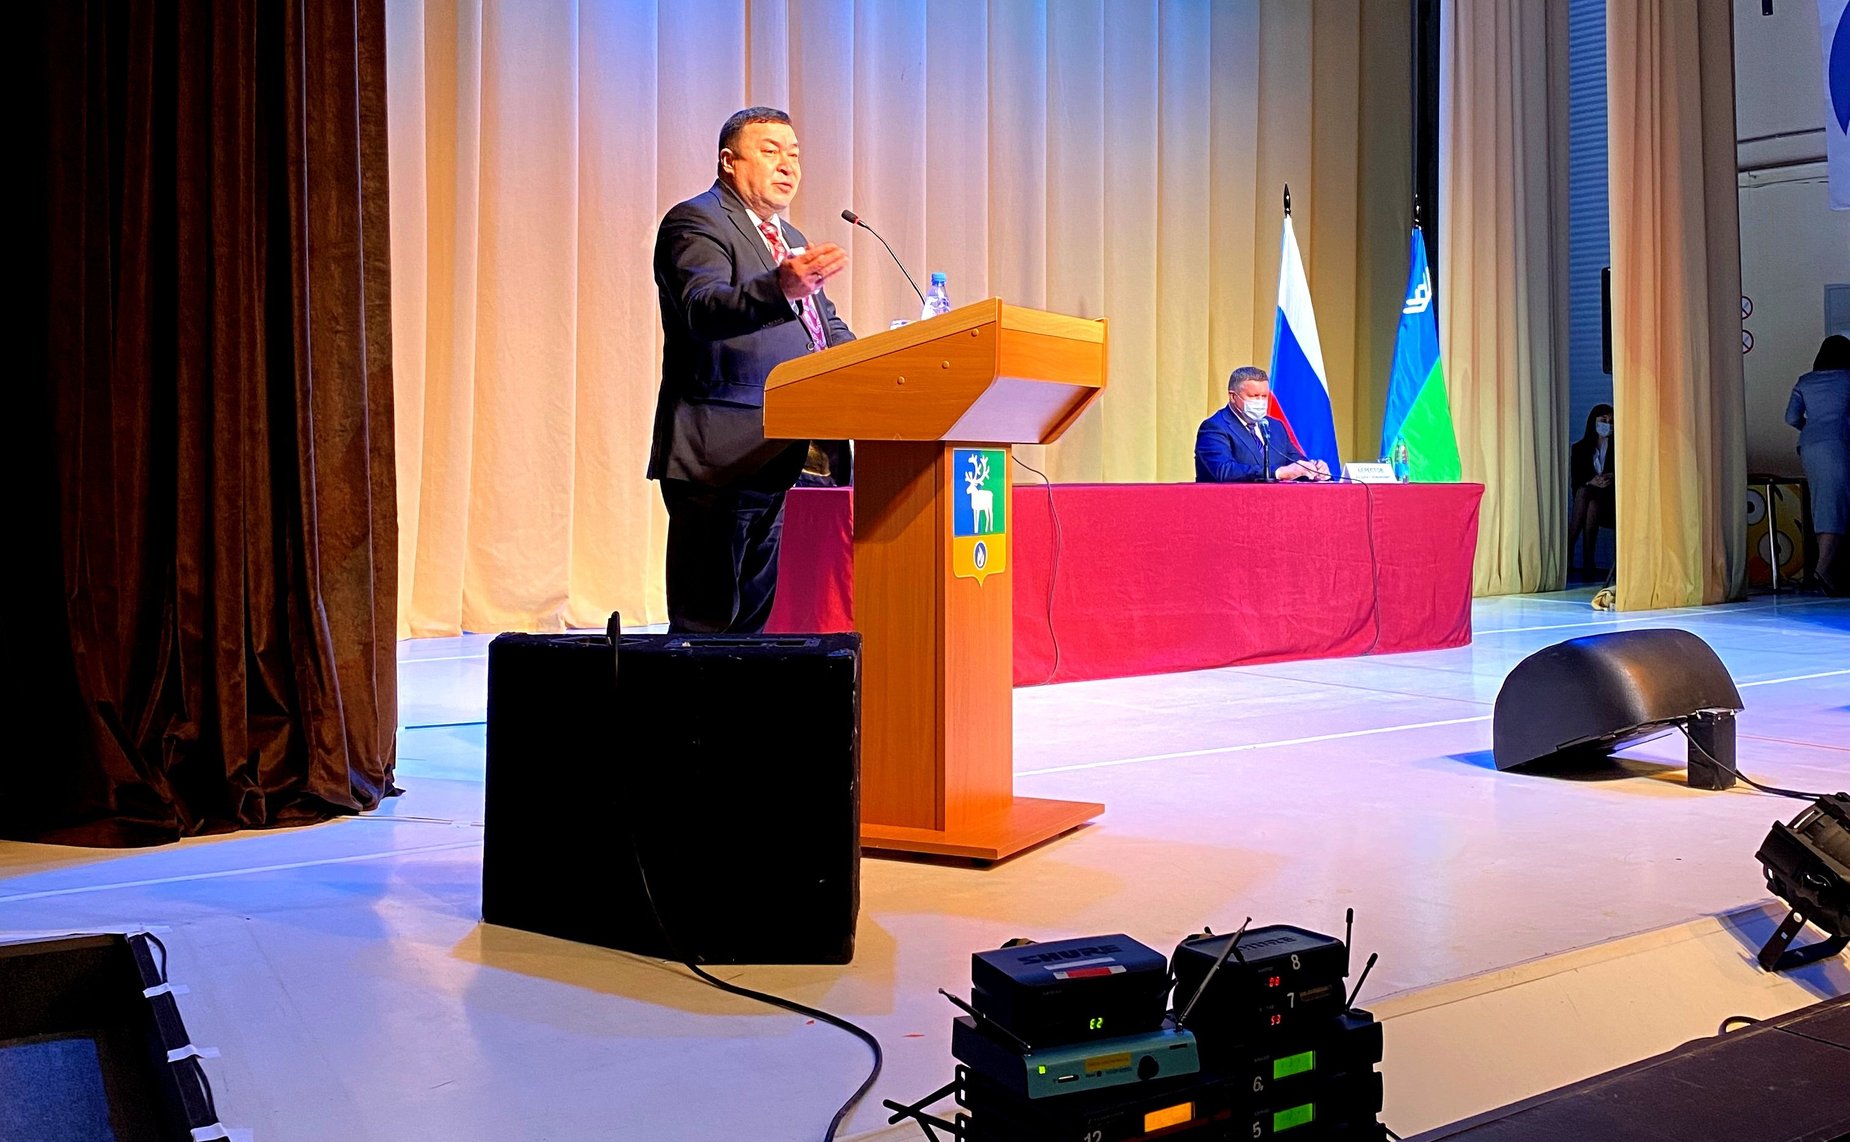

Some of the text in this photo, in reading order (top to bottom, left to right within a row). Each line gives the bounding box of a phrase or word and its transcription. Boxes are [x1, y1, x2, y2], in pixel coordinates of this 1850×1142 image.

[1018, 944, 1123, 965] SHURE
[1291, 953, 1301, 971] 8
[1286, 991, 1295, 1009] 7
[1083, 1130, 1102, 1142] 12
[1252, 1121, 1262, 1138] 5
